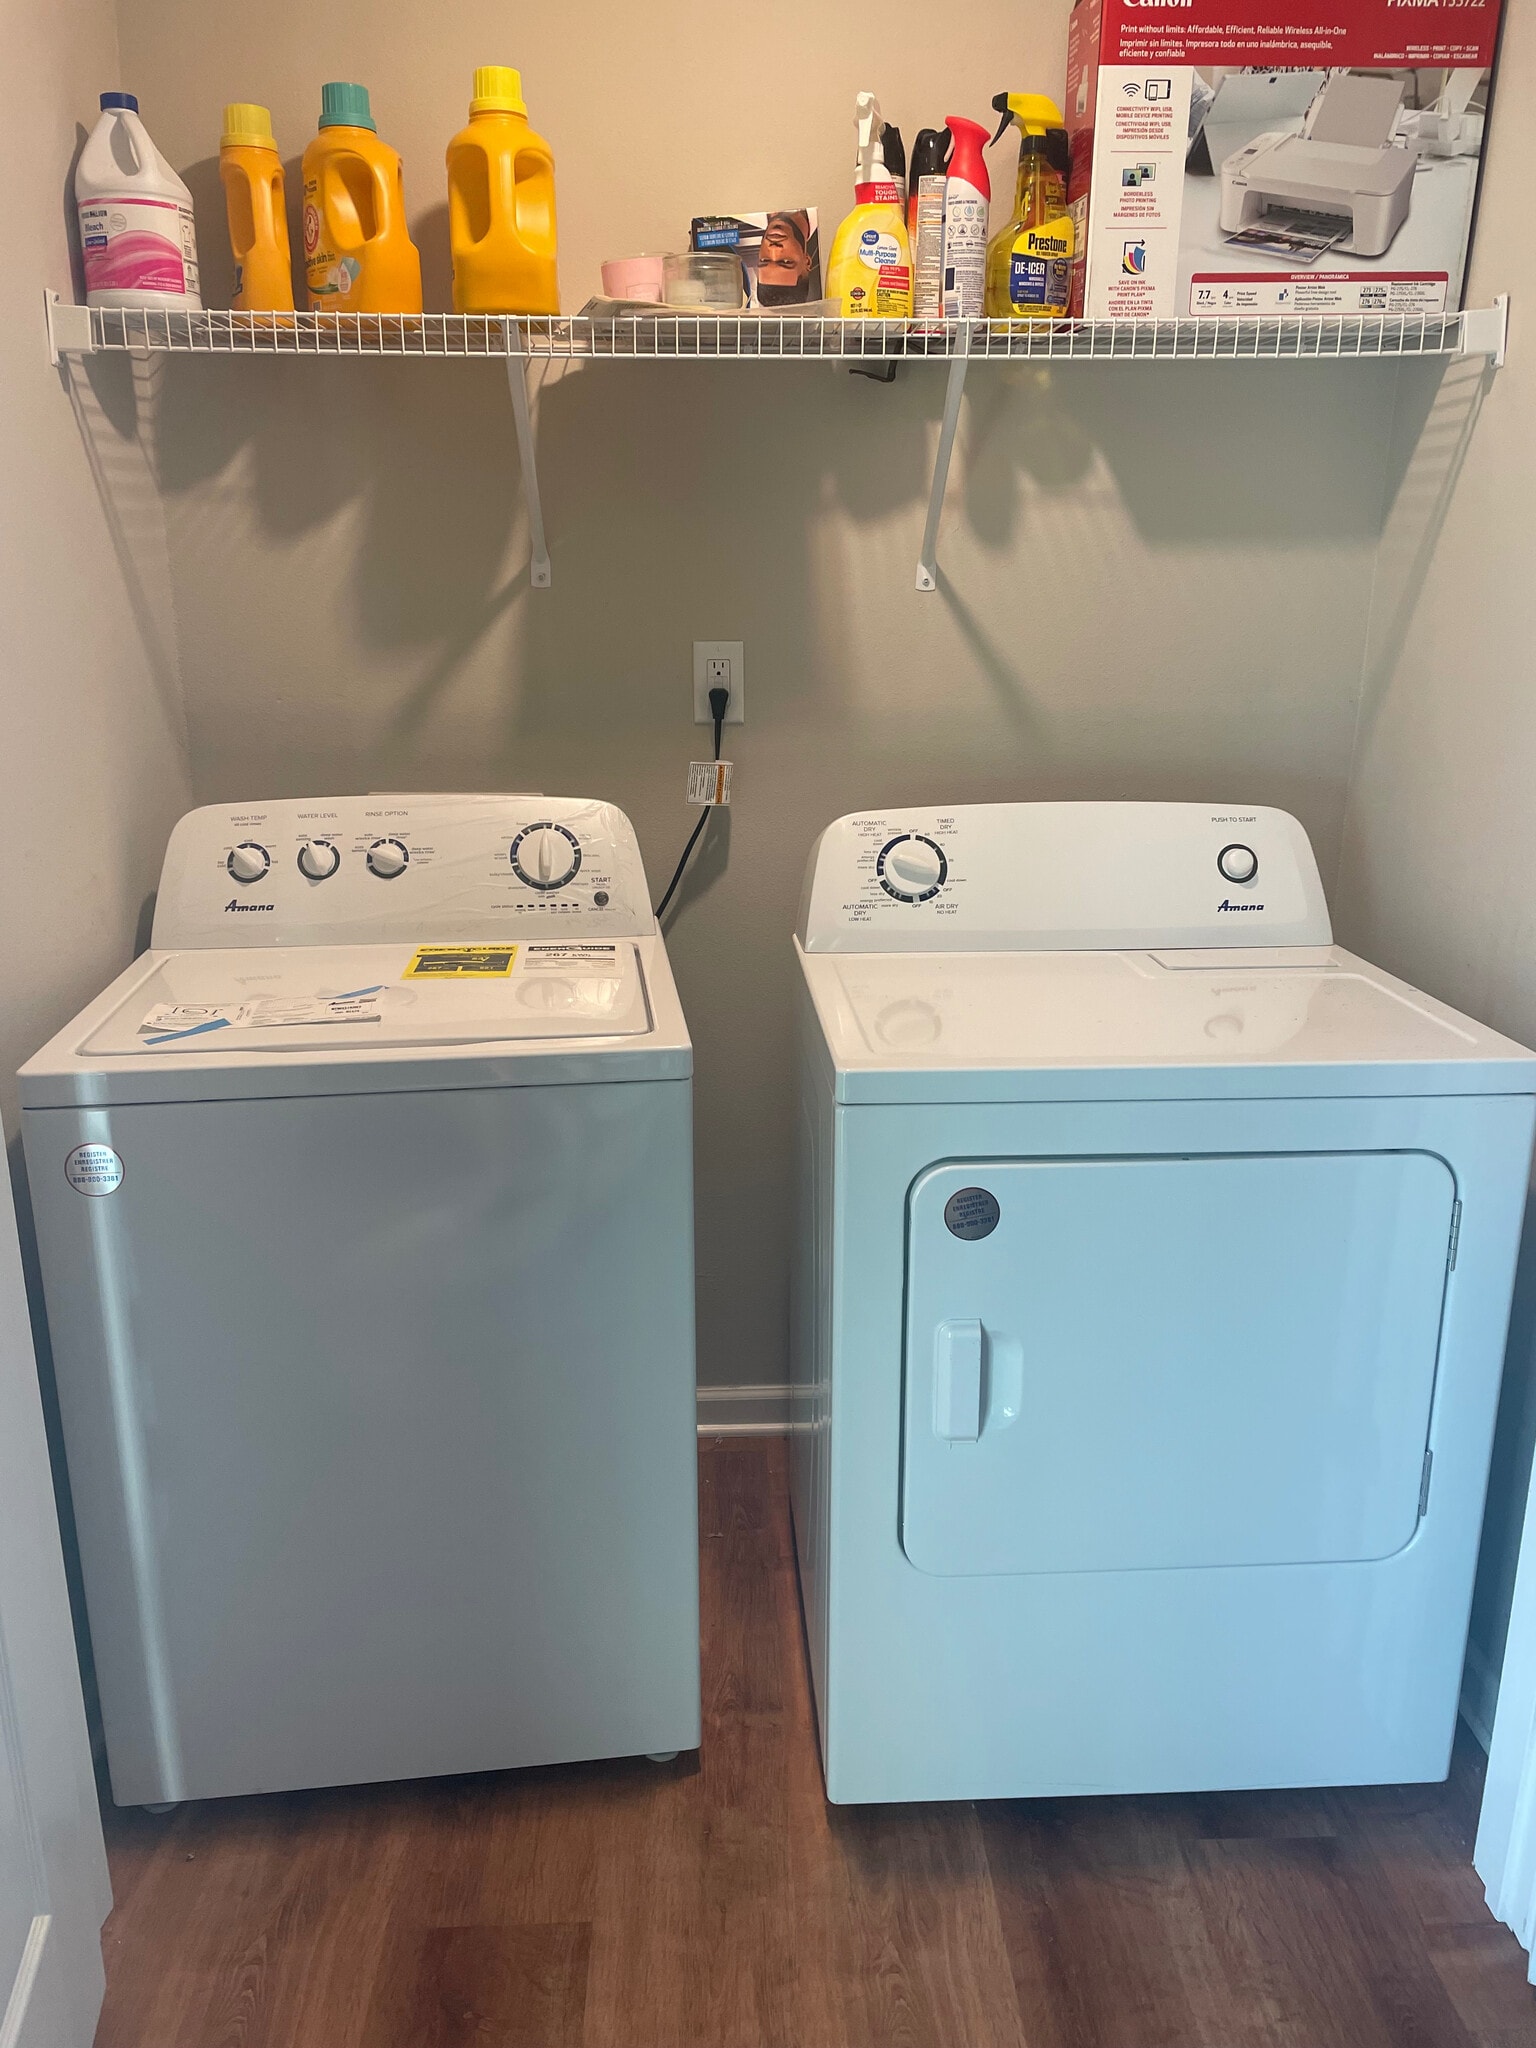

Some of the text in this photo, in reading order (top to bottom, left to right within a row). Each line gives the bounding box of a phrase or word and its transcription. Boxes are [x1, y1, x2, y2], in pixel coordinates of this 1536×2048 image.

[1120, 24, 1347, 36] Print without limits: Affordable, Efficient, Reliable Wireless All-in-One
[1119, 39, 1149, 50] Imprimir
[1149, 39, 1159, 48] sin
[1185, 40, 1220, 50] Impresora
[1220, 40, 1236, 49] todo
[1260, 40, 1299, 50] inalámbrica,
[1300, 40, 1333, 51] asequible,
[1119, 49, 1149, 58] eficiente
[1155, 49, 1186, 58] confiable
[1027, 233, 1067, 253] Prestone
[860, 249, 897, 258] Multi-Purpose
[874, 257, 896, 265] Cleaner
[1014, 262, 1045, 275] DE-ICER
[1197, 290, 1211, 300] 7.7
[1222, 290, 1228, 300] 4
[224, 899, 275, 912] Amana
[1217, 899, 1265, 912] Amana
[956, 1194, 983, 1204] REGISTER
